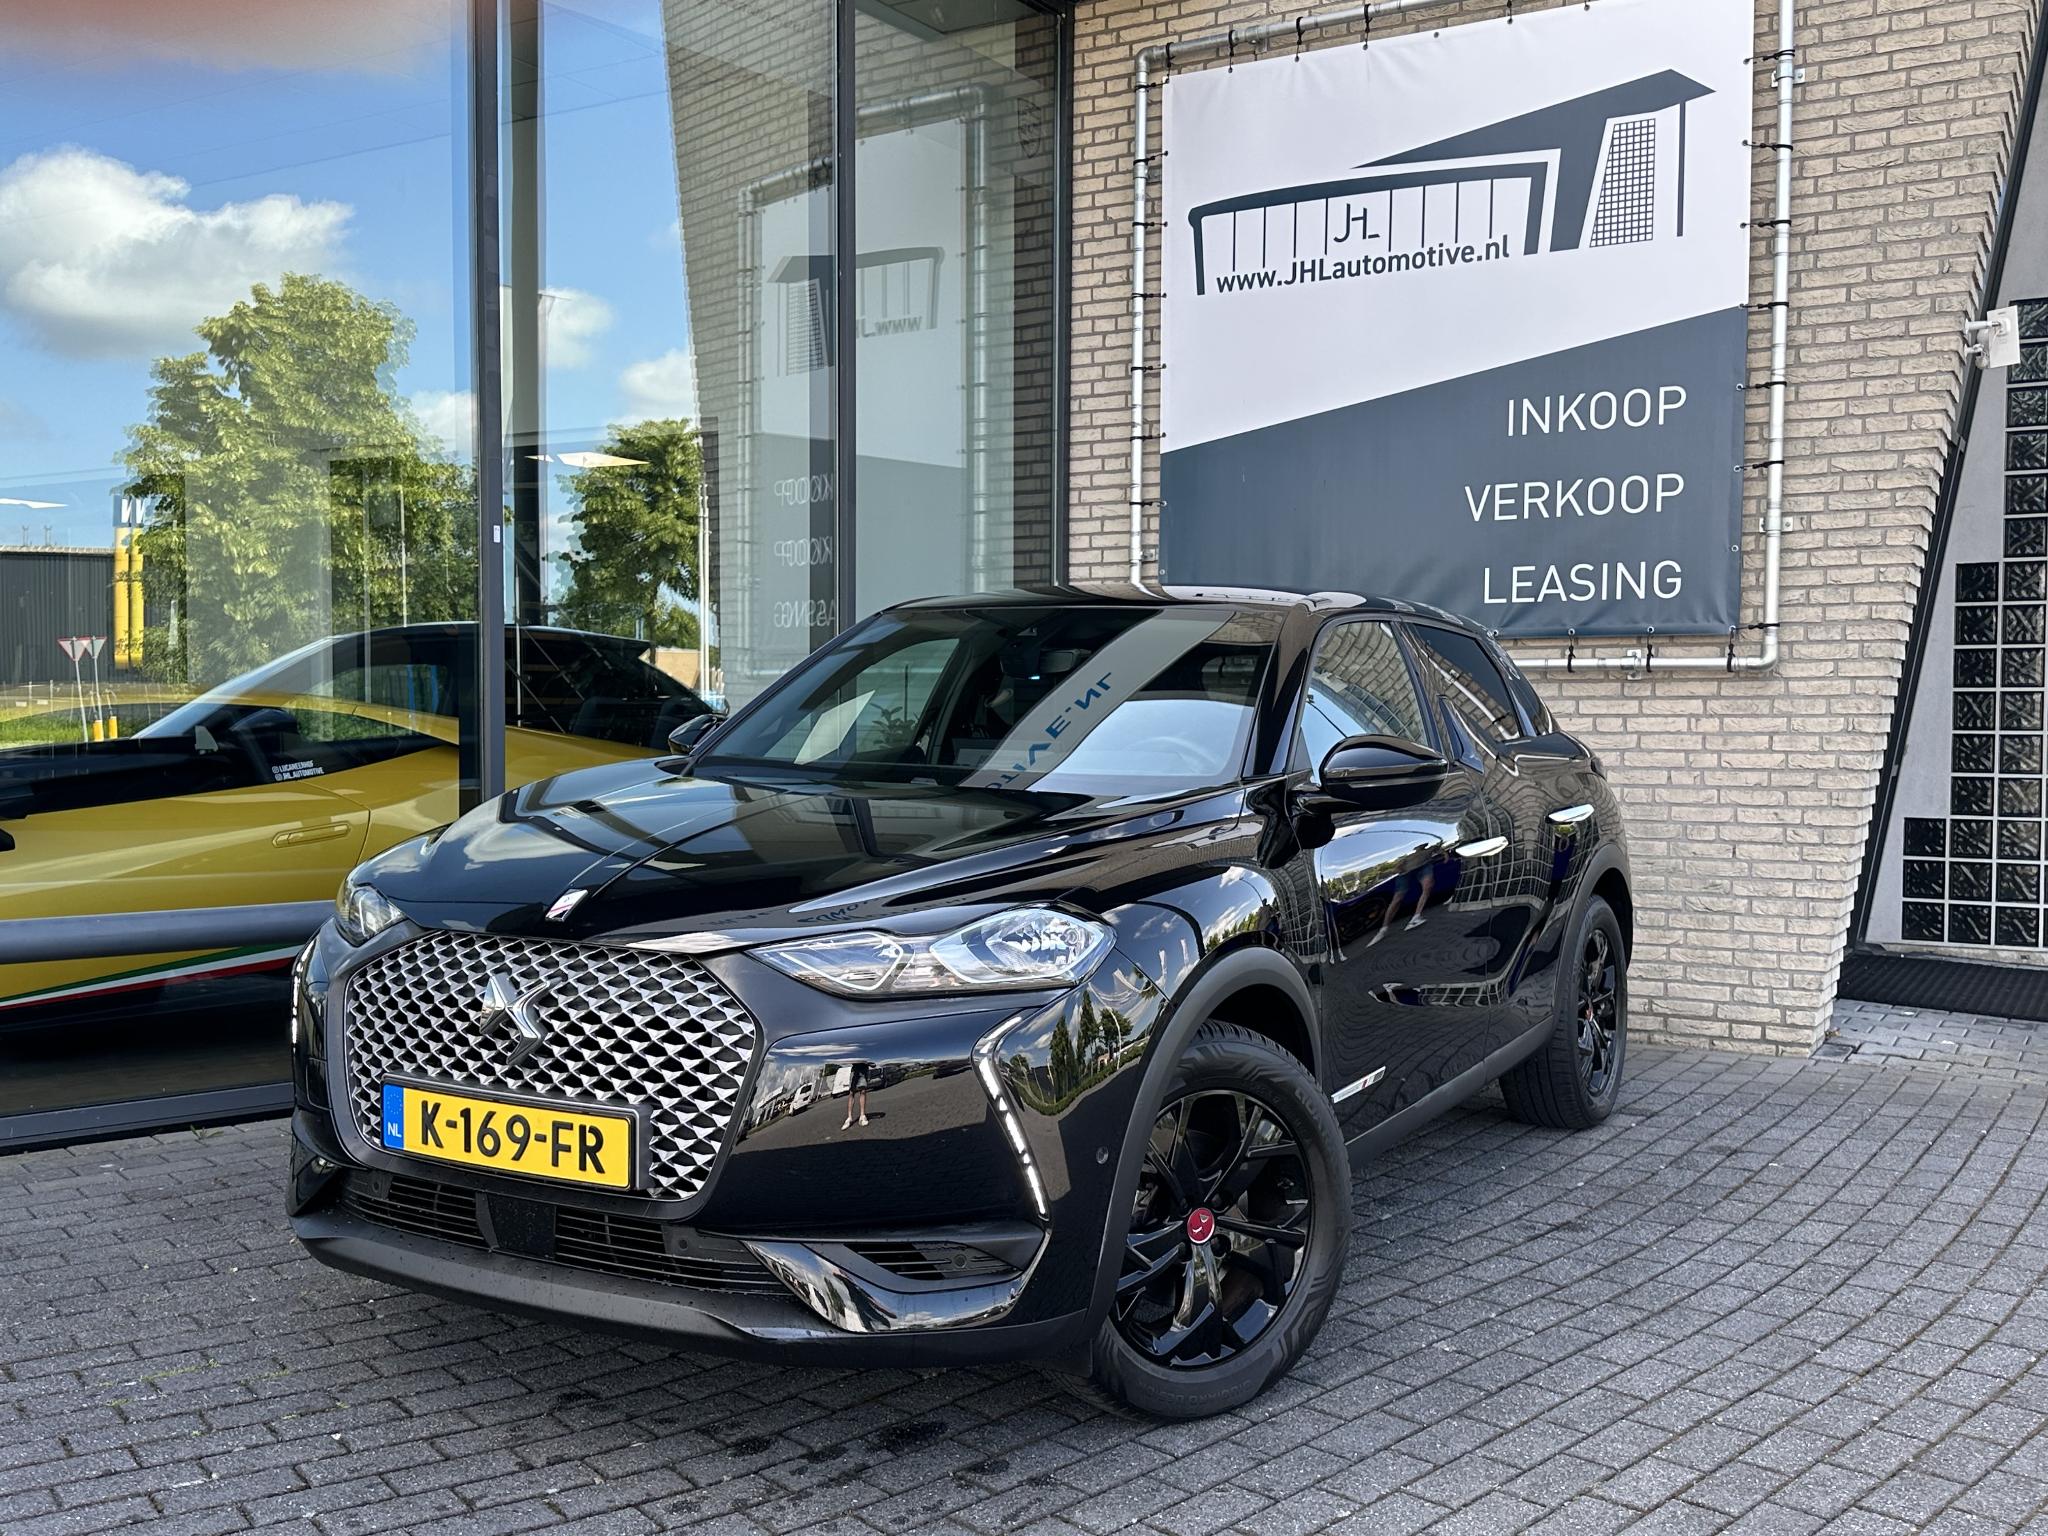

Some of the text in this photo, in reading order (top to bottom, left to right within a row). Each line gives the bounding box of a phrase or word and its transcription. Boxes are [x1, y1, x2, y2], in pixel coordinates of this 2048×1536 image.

[1333, 203, 1381, 243] JHL
[1216, 234, 1510, 294] www.JHLautomotive.nl
[1507, 385, 1687, 437] INKOOP
[1464, 473, 1685, 522] VERKOOP
[1483, 560, 1682, 604] LEASING
[387, 1122, 402, 1138] NL
[421, 1100, 606, 1174] K-169-FR
